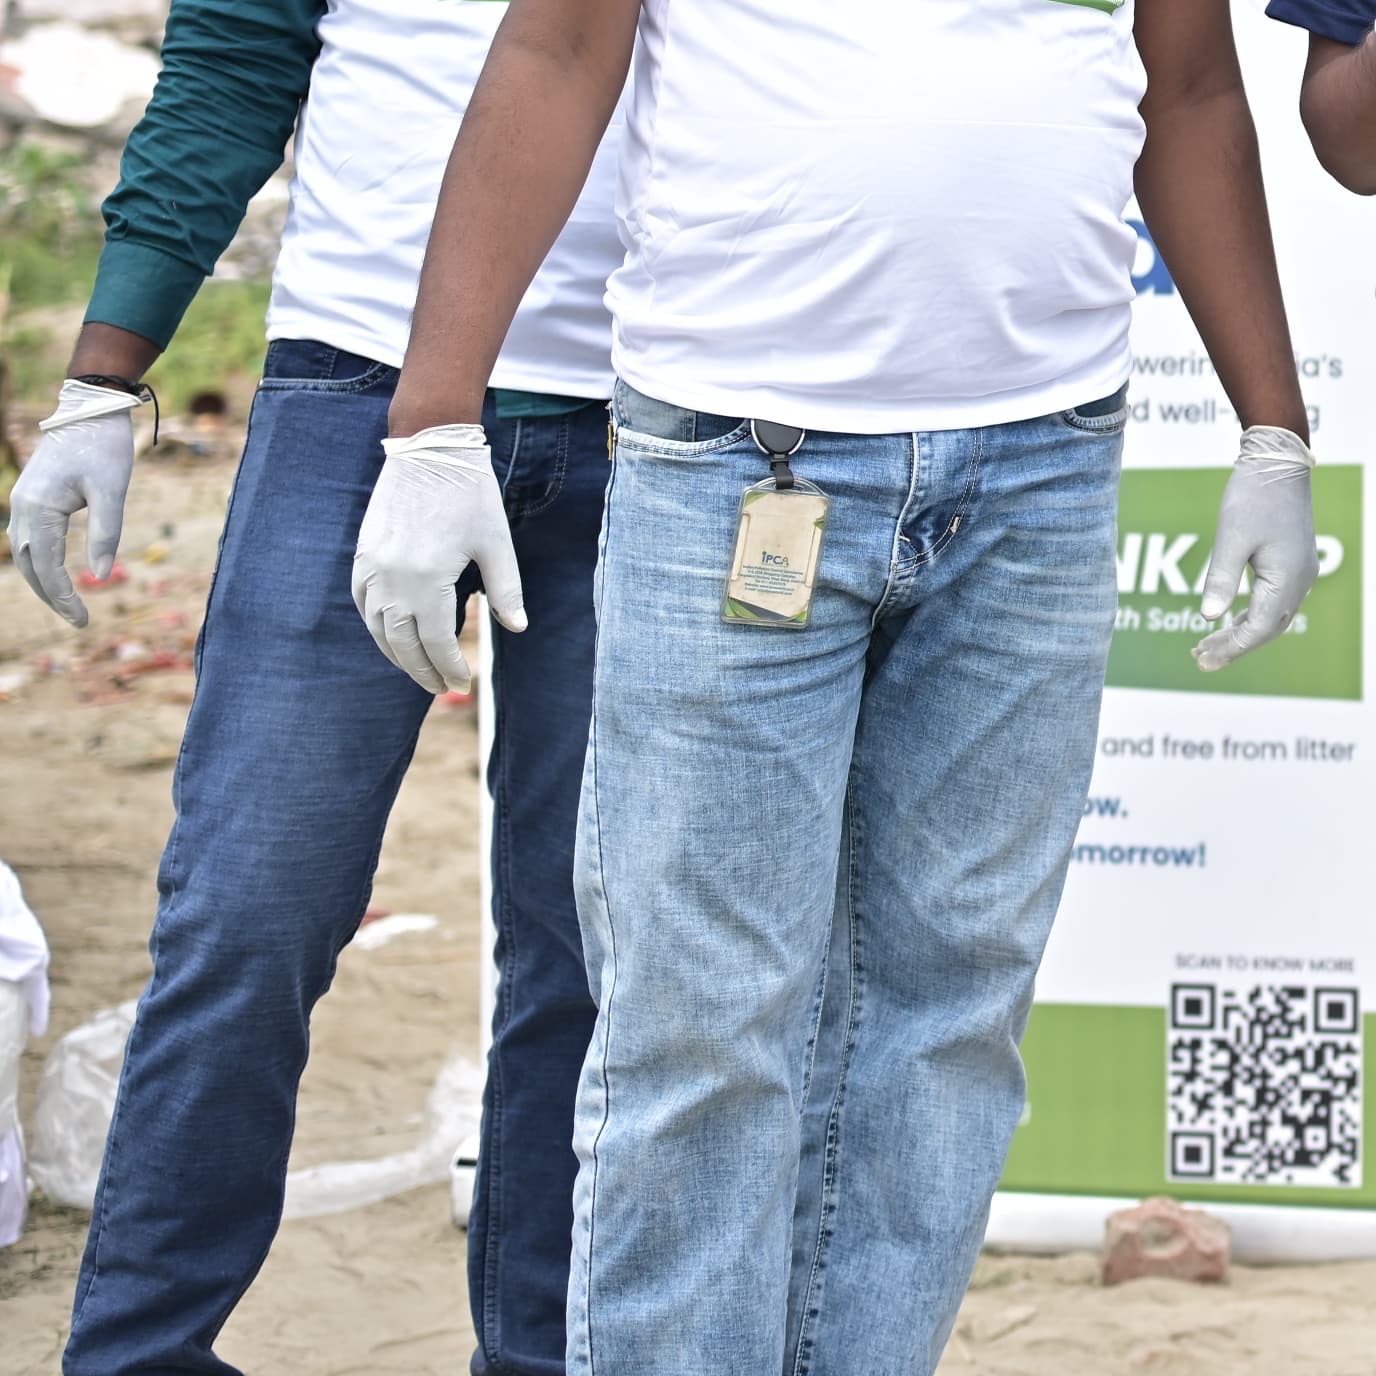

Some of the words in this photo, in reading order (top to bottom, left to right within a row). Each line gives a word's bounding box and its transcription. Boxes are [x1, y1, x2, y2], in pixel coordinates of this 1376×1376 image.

[1101, 735, 1155, 759] and
[1161, 734, 1215, 759] free
[1220, 735, 1288, 762] from
[1294, 736, 1356, 763] litter
[1174, 953, 1222, 971] SCAN
[1226, 954, 1250, 972] TO
[1252, 955, 1305, 973] KNOW
[1308, 956, 1356, 974] MORE
